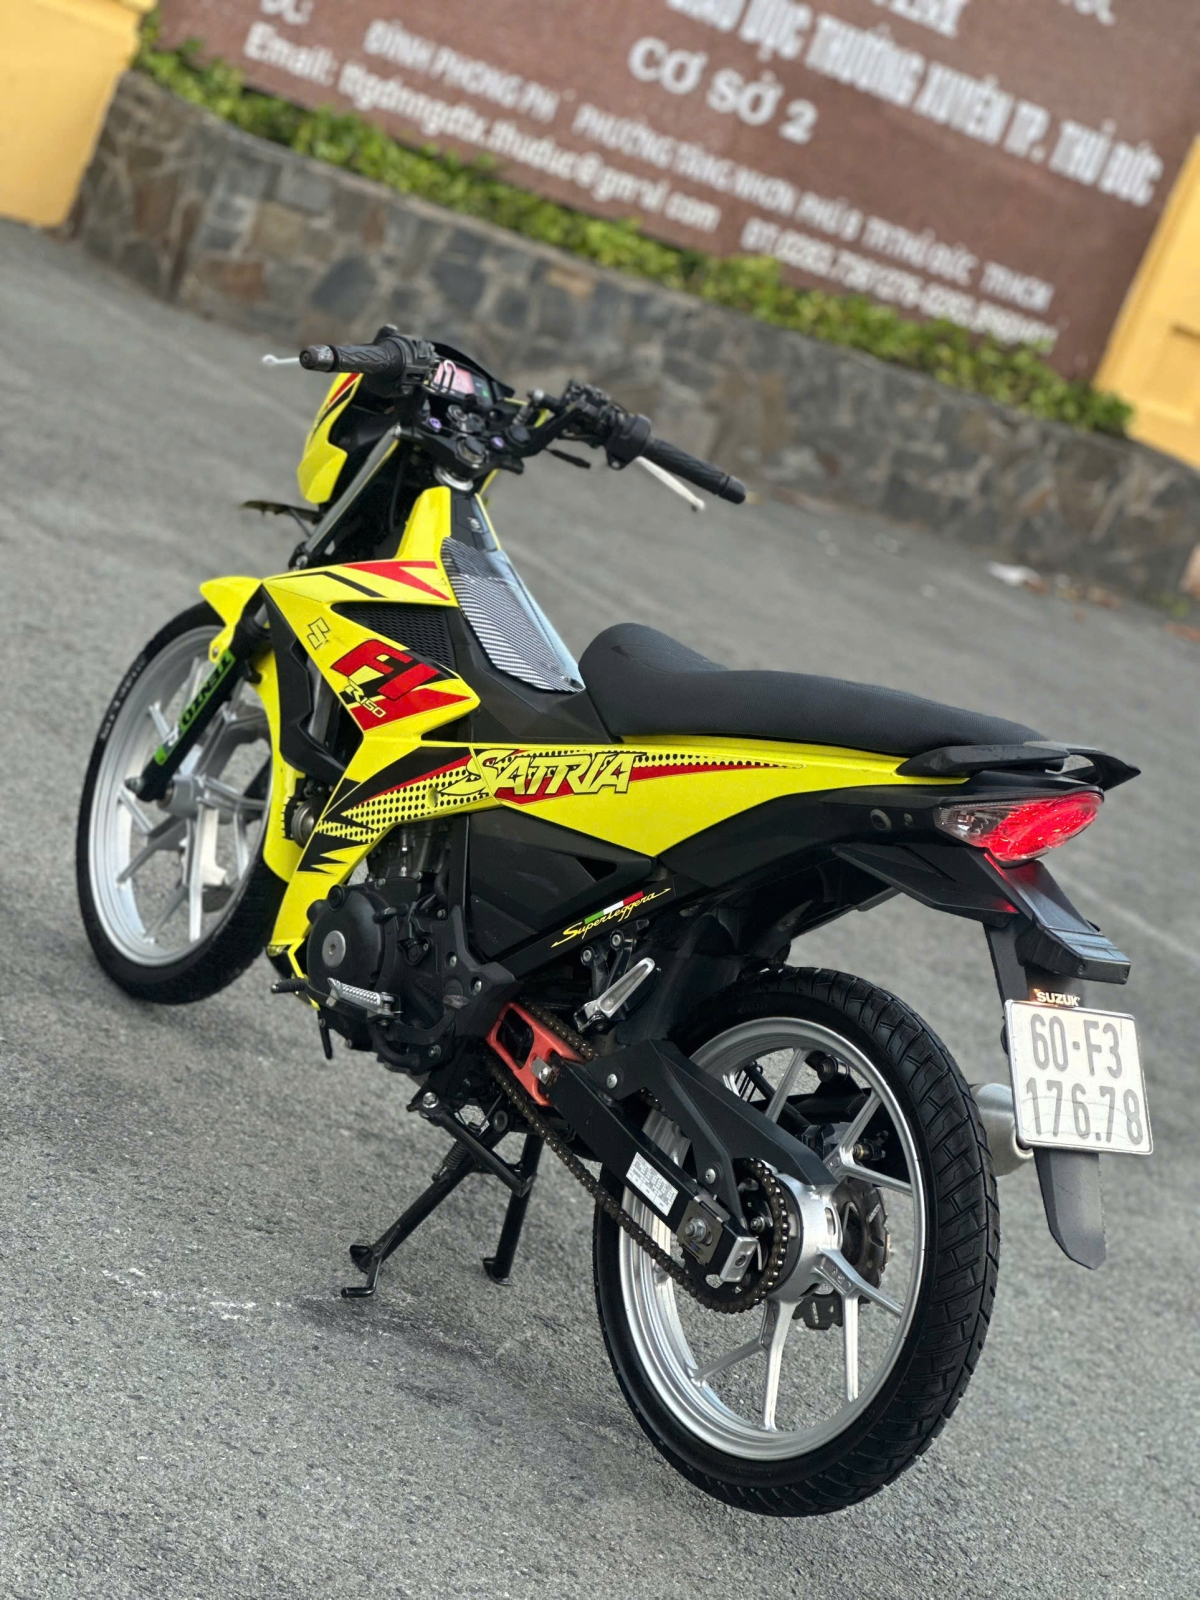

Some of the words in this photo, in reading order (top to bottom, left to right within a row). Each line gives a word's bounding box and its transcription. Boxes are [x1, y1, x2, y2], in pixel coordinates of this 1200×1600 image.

[628, 36, 708, 96] CƠ
[706, 70, 785, 126] SỞ
[779, 99, 818, 144] 2
[346, 675, 387, 719] R150
[437, 748, 648, 796] SATRIA
[551, 887, 671, 948] Superleggera
[1030, 1013, 1123, 1079] 60-F3
[1026, 1077, 1144, 1145] 176.78
